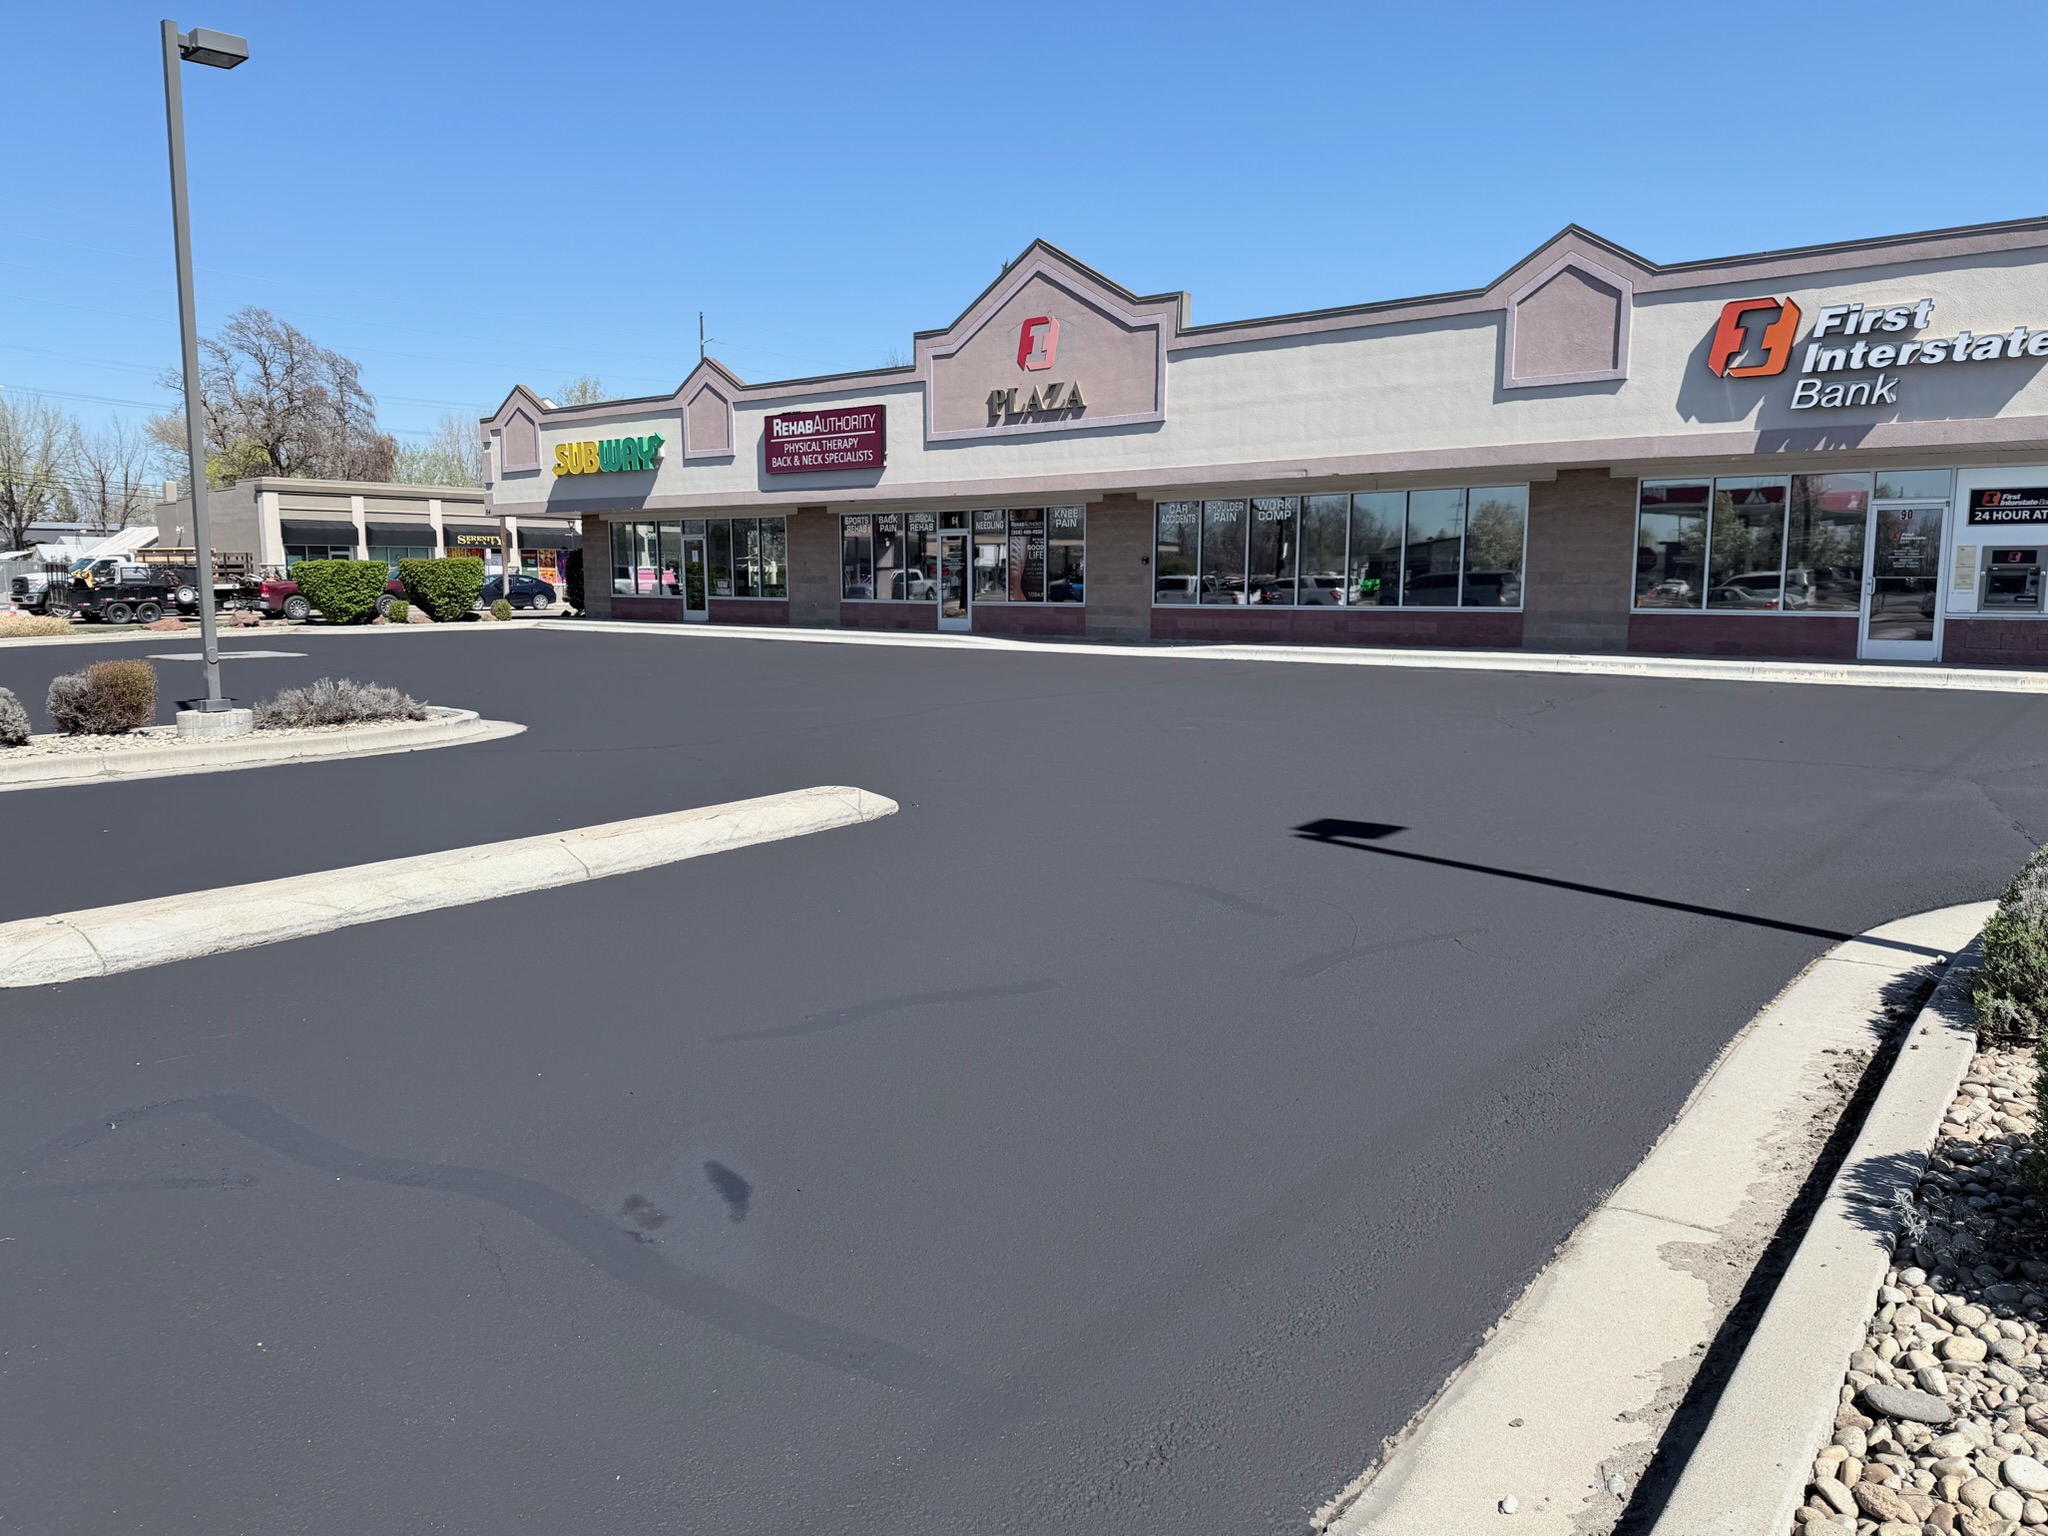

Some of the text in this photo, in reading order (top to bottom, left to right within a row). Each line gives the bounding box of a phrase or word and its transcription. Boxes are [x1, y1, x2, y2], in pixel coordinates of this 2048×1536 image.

[1812, 298, 1935, 338] First
[1801, 326, 2048, 374] Interstate
[1790, 372, 1900, 410] Bank
[990, 380, 1088, 417] PLAZA
[784, 437, 858, 454] PHYSICAL THERAPY
[552, 432, 665, 479] SUBWAY
[772, 450, 873, 468] BACK & NECK SPECIALISTS
[1169, 504, 1188, 514] CAR
[1207, 502, 1244, 513] SHOULDER
[1258, 500, 1292, 511] WORK
[983, 511, 996, 521] DRY
[1054, 508, 1078, 518] KNEE
[1213, 512, 1237, 522] PAIN
[1258, 510, 1292, 521] COMP
[1901, 509, 1913, 520] 90
[1974, 511, 1990, 520] 24
[1992, 510, 2030, 520] HOUR
[844, 516, 869, 525] SPORTS
[878, 515, 899, 524] BACK
[908, 514, 935, 523] SURGICAL
[951, 516, 959, 525] 64
[1055, 518, 1077, 528] PAIN
[1161, 514, 1196, 524] ACCIDENTS
[846, 524, 868, 533] REHAB
[879, 524, 898, 533] PAIN
[910, 523, 934, 532] REHAB
[975, 521, 1004, 530] NEEDLING
[1028, 551, 1044, 559] LIFE
